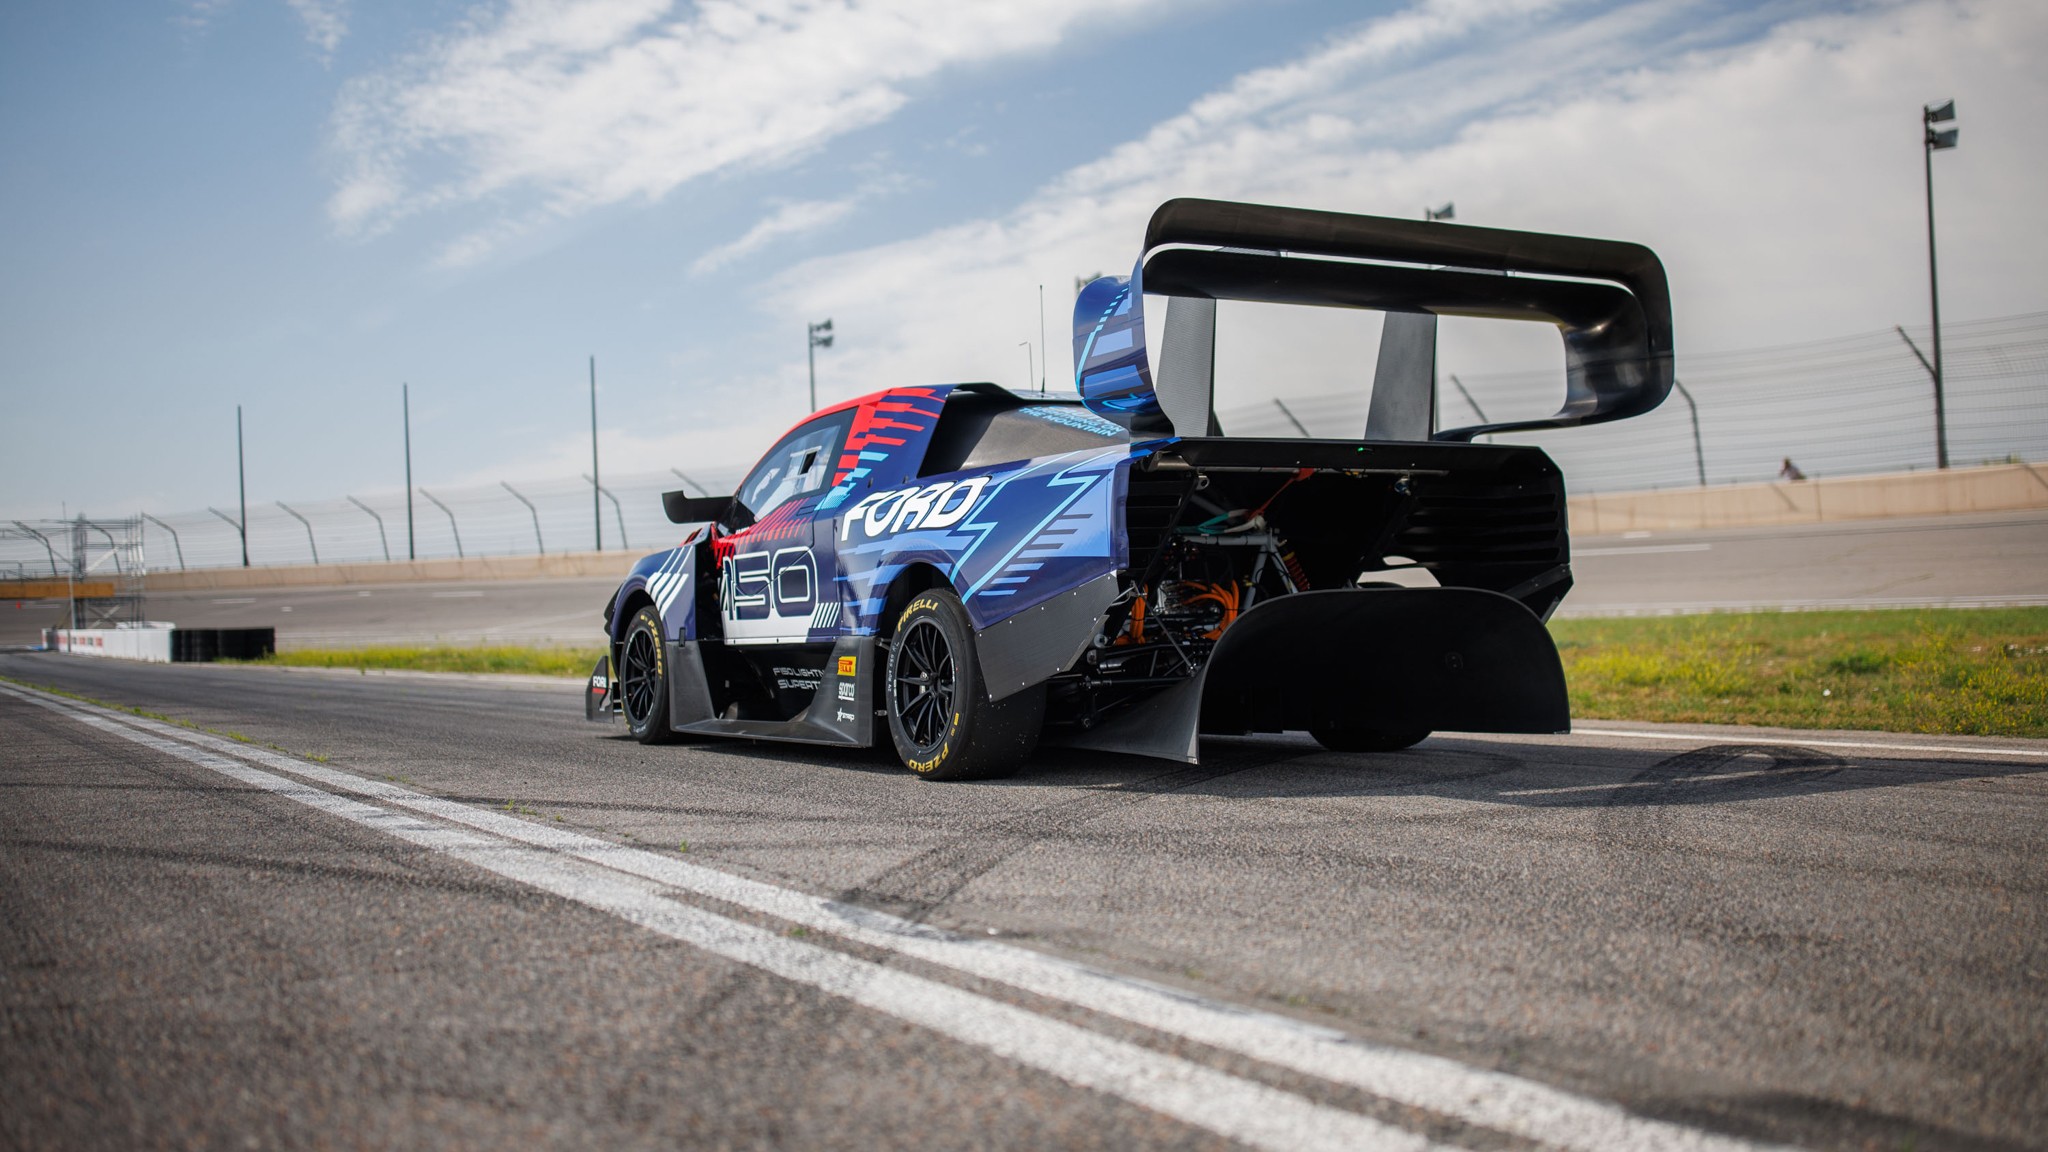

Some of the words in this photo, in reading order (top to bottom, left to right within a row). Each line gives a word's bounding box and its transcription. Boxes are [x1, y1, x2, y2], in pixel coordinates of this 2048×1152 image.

[1042, 412, 1119, 438] MOUNTAIN
[841, 475, 992, 542] FORD
[897, 599, 939, 632] PIRELLI
[777, 679, 821, 691] SUPERT
